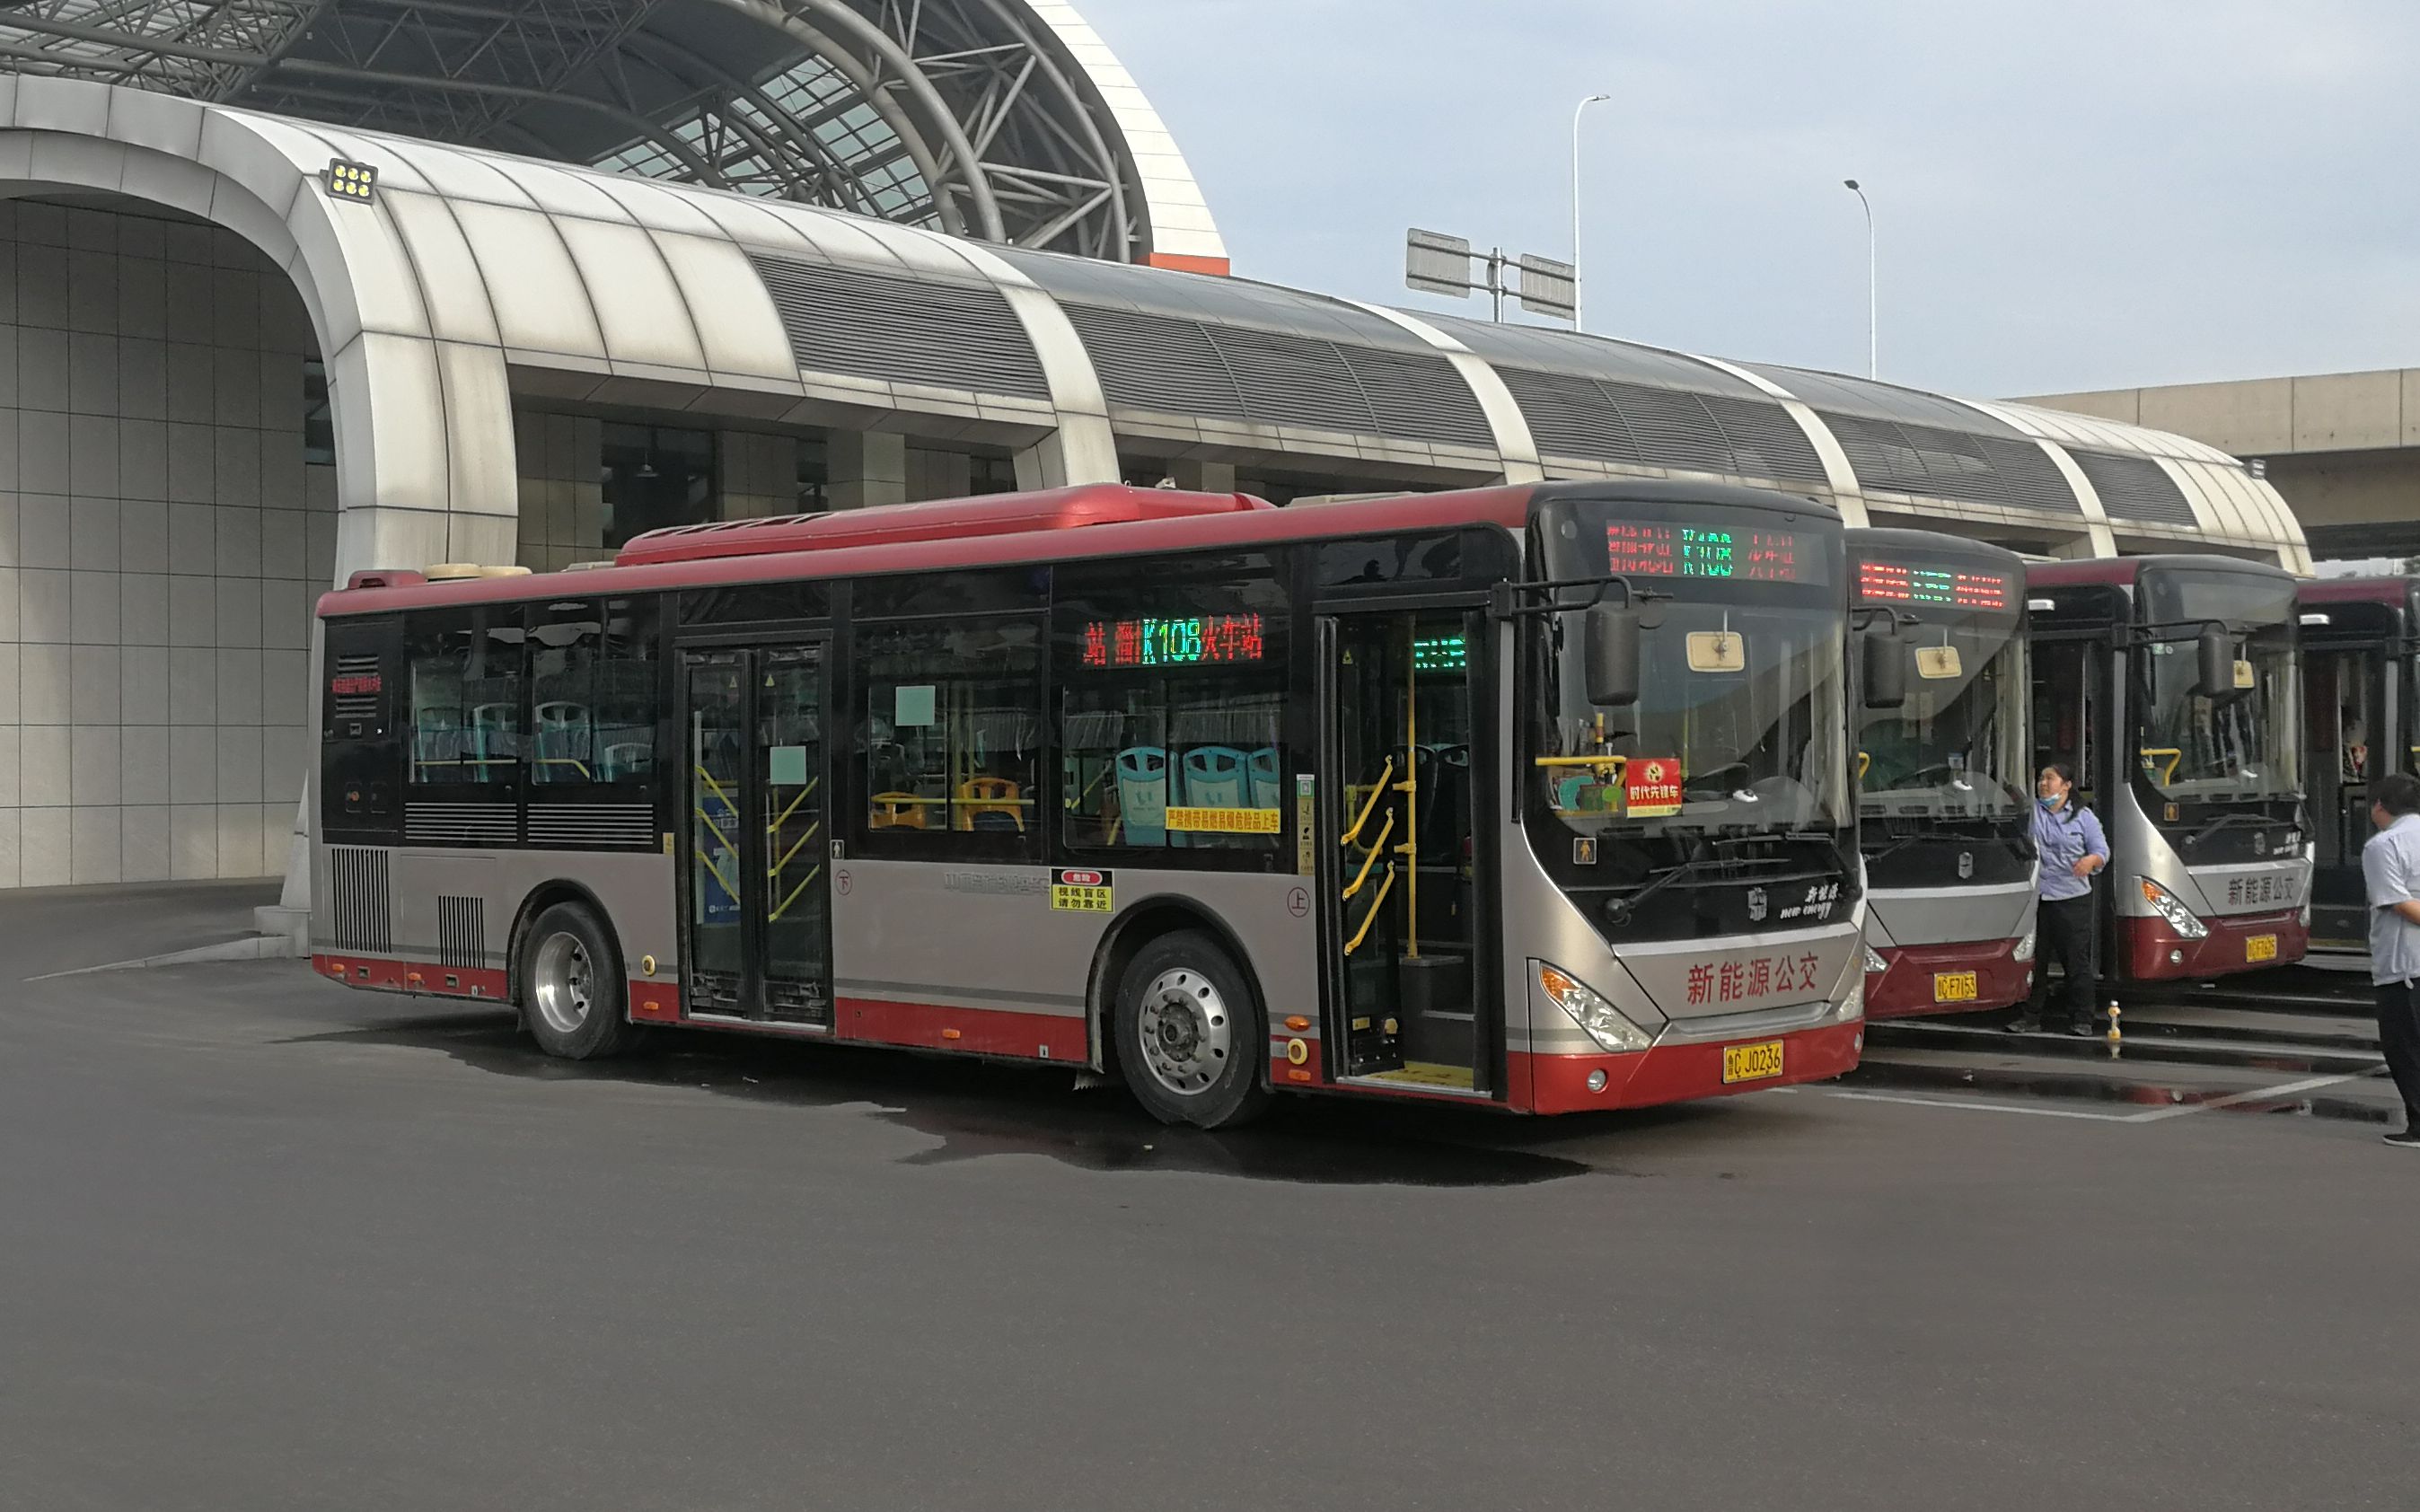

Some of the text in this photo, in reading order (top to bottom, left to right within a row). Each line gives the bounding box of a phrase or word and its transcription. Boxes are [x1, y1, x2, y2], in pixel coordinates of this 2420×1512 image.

[1142, 618, 1201, 664] K108
[1201, 613, 1263, 660] 火车站
[1630, 785, 1678, 800] 时代先锋车
[1168, 809, 1279, 831] 严禁携带易燃易爆危险品上车
[1058, 886, 1107, 899] 视线盲区
[1291, 891, 1307, 910] 上
[2227, 875, 2295, 907] 新能源公交
[1058, 899, 1107, 910] 请勿靠近
[1687, 951, 1820, 1006] 新能源公交
